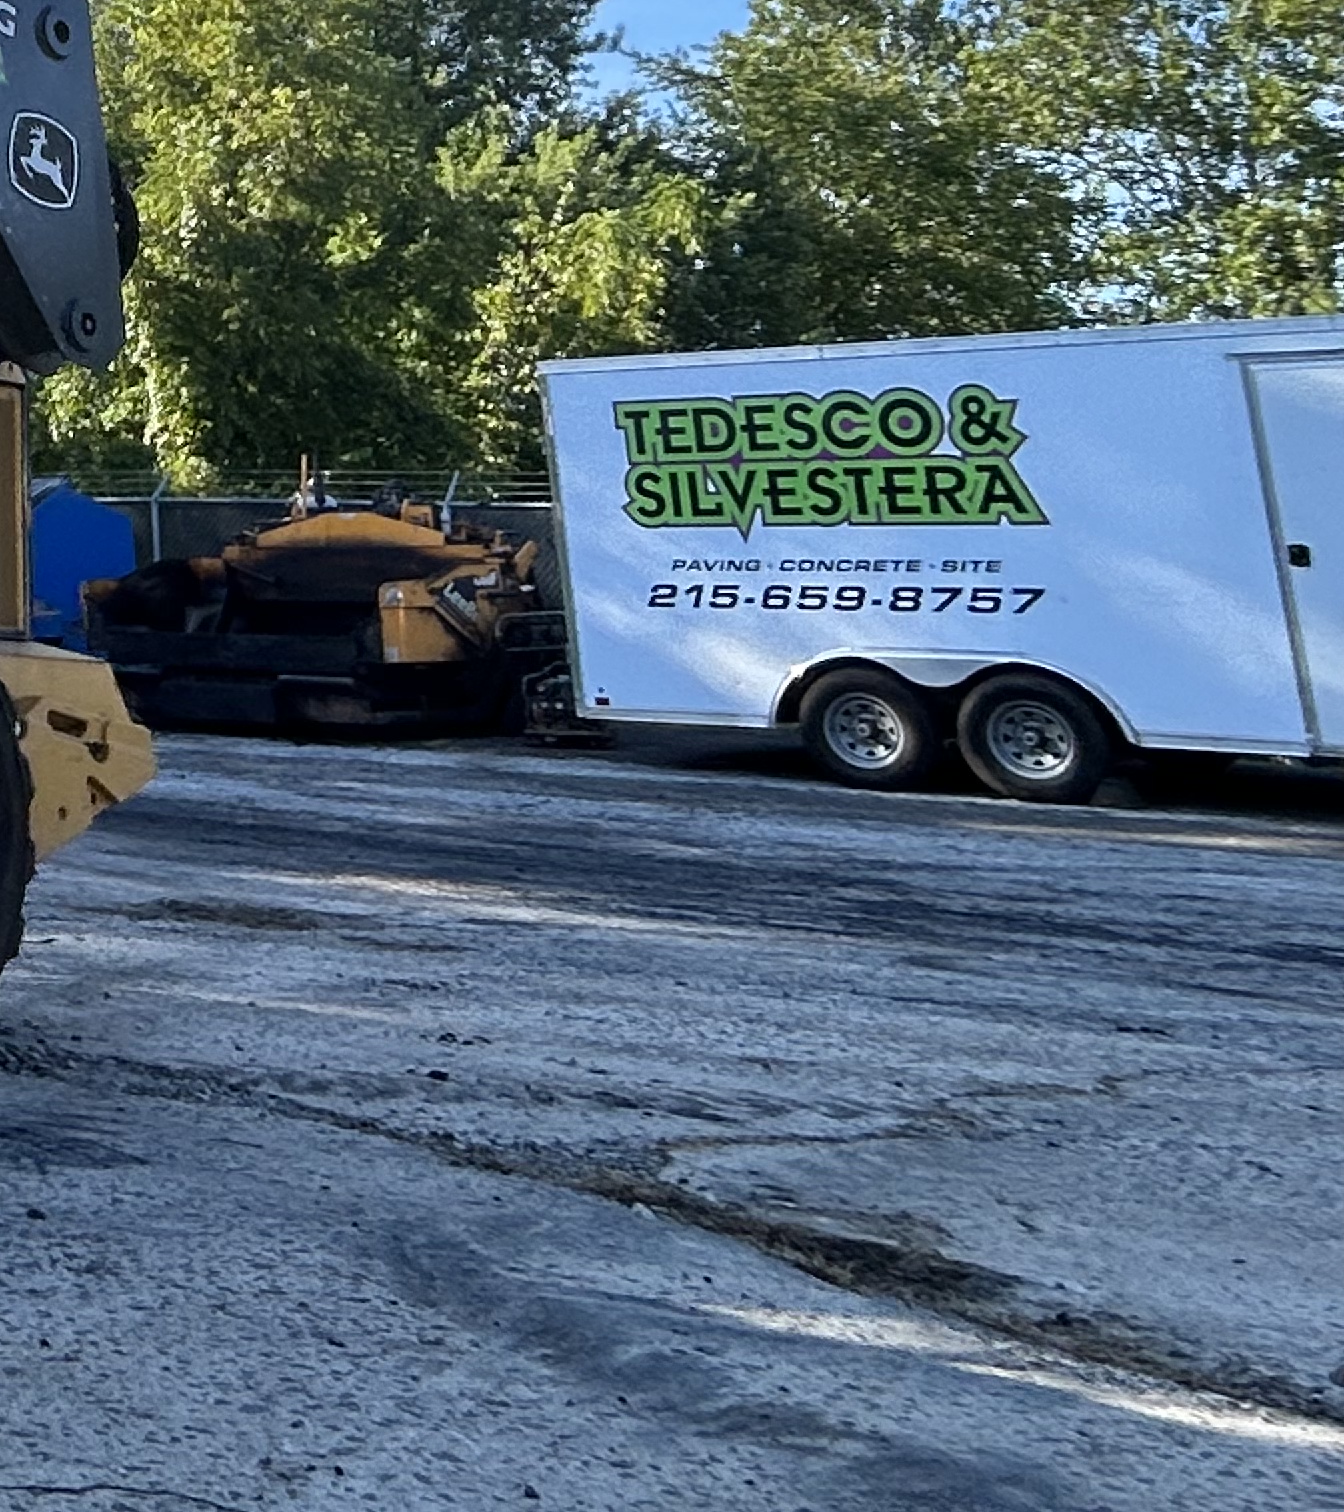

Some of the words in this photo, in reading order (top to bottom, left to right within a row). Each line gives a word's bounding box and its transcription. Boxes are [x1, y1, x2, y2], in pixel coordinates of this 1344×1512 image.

[623, 397, 933, 455] TEDESCO
[959, 394, 1010, 447] &
[634, 464, 1031, 518] SILVESTERA
[671, 558, 761, 573] PAVING
[778, 559, 922, 574] CONCRETE
[940, 559, 1003, 574] SITE
[647, 583, 1047, 615] 215-659-8757
